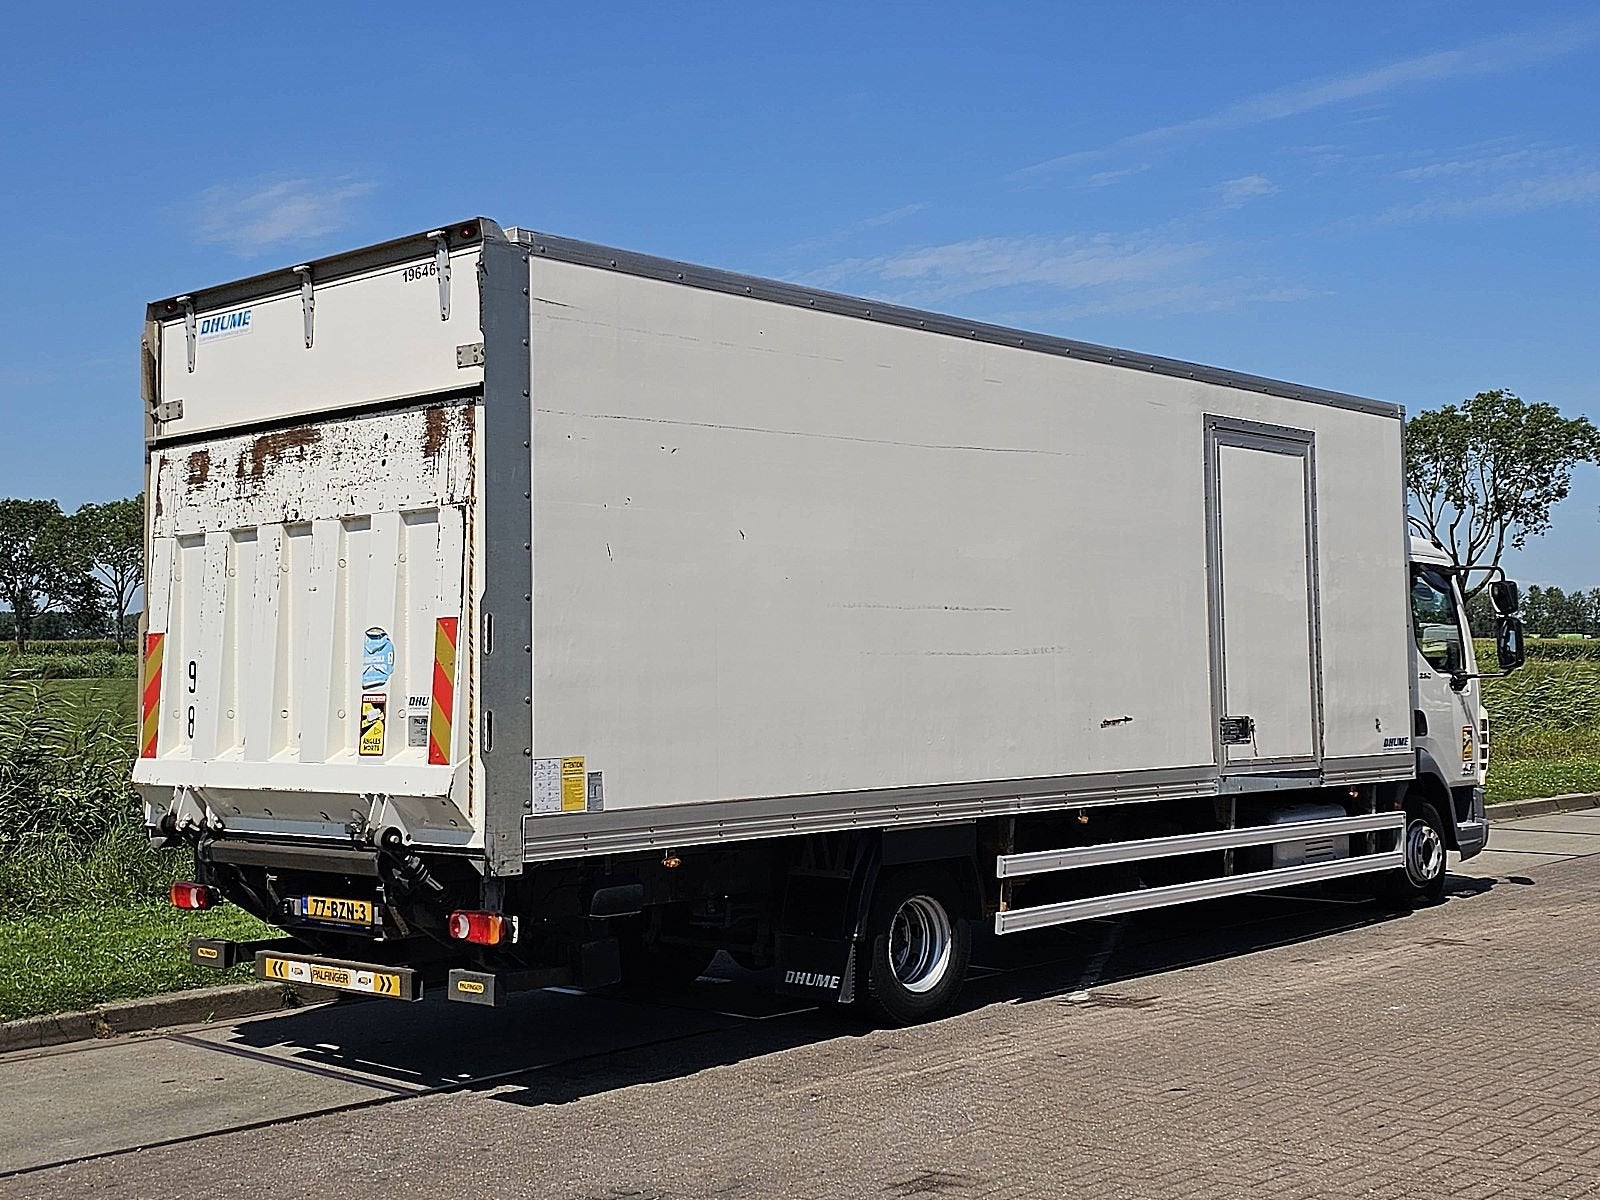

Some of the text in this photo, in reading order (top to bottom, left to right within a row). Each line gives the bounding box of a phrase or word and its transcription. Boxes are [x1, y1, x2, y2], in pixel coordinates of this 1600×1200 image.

[403, 262, 436, 282] 19646
[201, 310, 251, 335] DHUME
[313, 899, 366, 921] 77-BZN-3
[784, 970, 840, 989] DHUME
